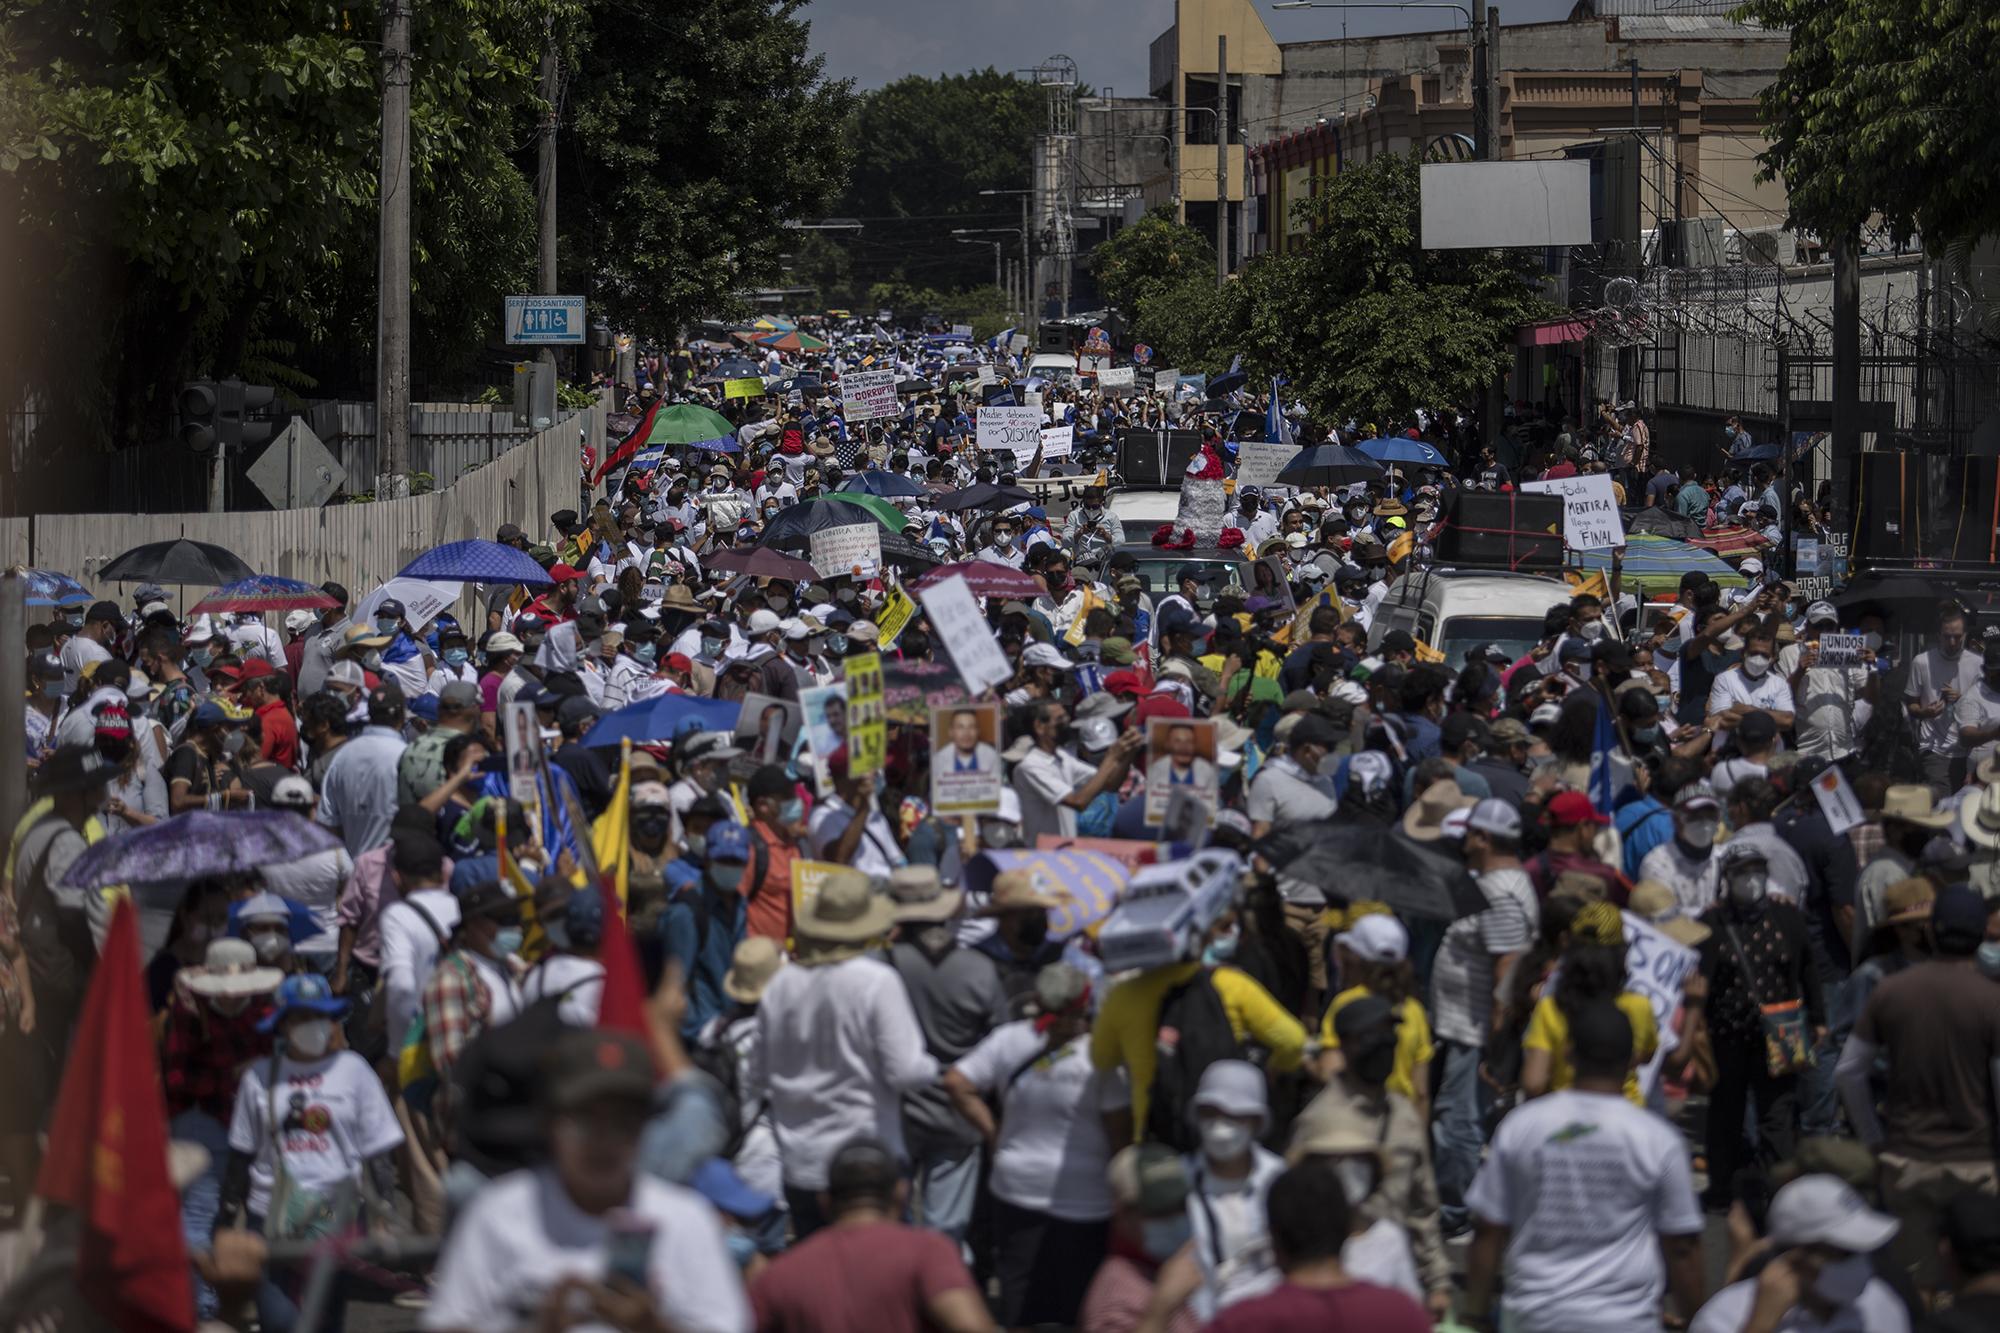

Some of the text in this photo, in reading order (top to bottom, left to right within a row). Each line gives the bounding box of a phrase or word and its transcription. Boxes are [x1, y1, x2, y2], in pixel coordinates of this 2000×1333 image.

[508, 299, 582, 307] SERVICIOS SANITARIOS
[855, 384, 895, 401] CORRUPTO
[980, 408, 1003, 419] Nadie
[1008, 419, 1019, 427] 40
[1546, 482, 1586, 495] A toda
[1568, 500, 1611, 515] MENTIRA
[1825, 533, 1840, 546] NO
[1796, 577, 1830, 589] ATENTA
